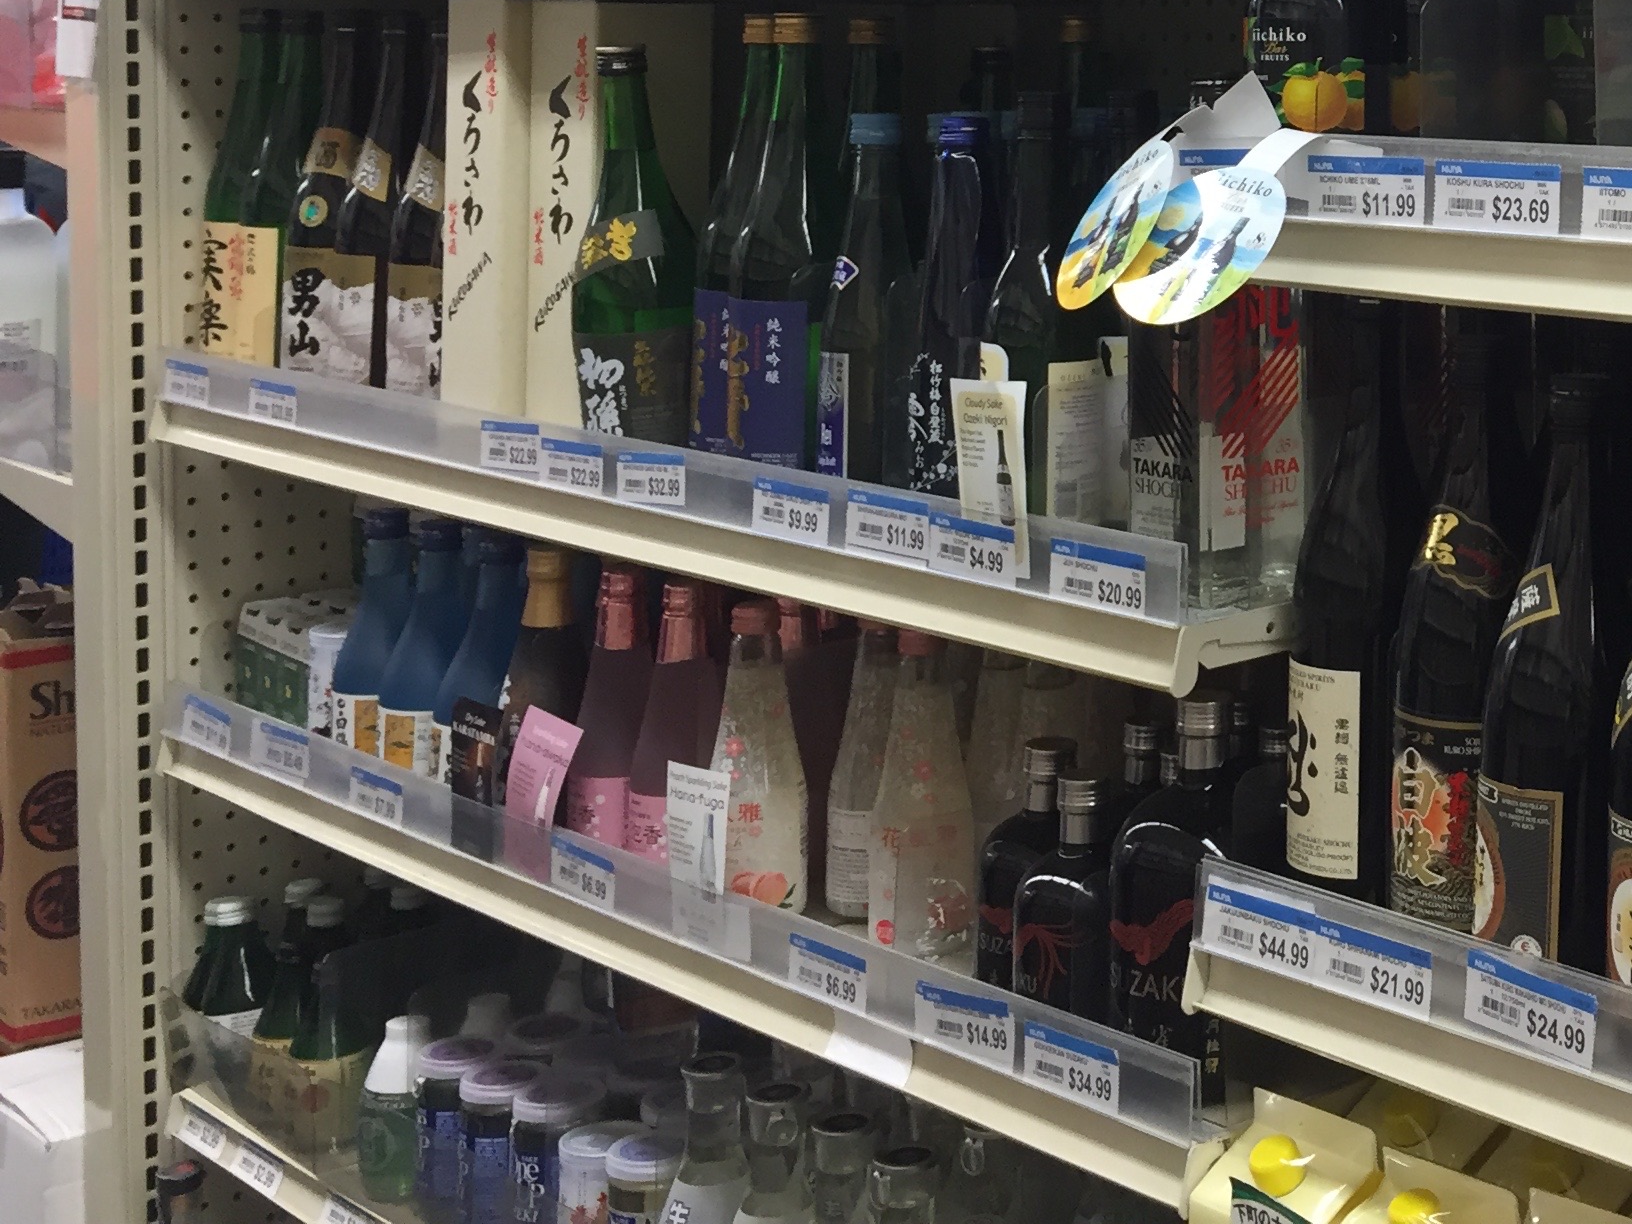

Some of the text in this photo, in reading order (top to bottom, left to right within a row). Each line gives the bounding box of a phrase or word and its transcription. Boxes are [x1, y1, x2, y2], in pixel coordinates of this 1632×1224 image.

[1252, 26, 1307, 44] iichiko
[1259, 53, 1290, 63] FRUITS
[462, 69, 484, 236] くろさわ
[548, 74, 574, 246] くろさわ
[1446, 178, 1526, 191] KOSHU KURA SHOCHU
[1362, 191, 1416, 219] $11.99
[1491, 194, 1551, 225] $23.69
[287, 267, 327, 357] 男山
[986, 398, 1004, 410] Sake
[509, 445, 538, 466] $22.99
[570, 466, 601, 488] $22.99
[648, 475, 680, 497] $32.99
[788, 506, 818, 532] $9.99
[886, 522, 925, 549] $11.99
[968, 544, 1004, 572] $4.99
[1097, 575, 1142, 606] $20.99
[582, 873, 607, 901] $6.99
[1258, 931, 1310, 970] $44.99
[825, 972, 856, 1003] $6.99
[1369, 965, 1425, 1007] $21.99
[966, 1020, 1008, 1050] $14.99
[1526, 1007, 1586, 1054] $24.99
[1068, 1065, 1113, 1100] $34.99
